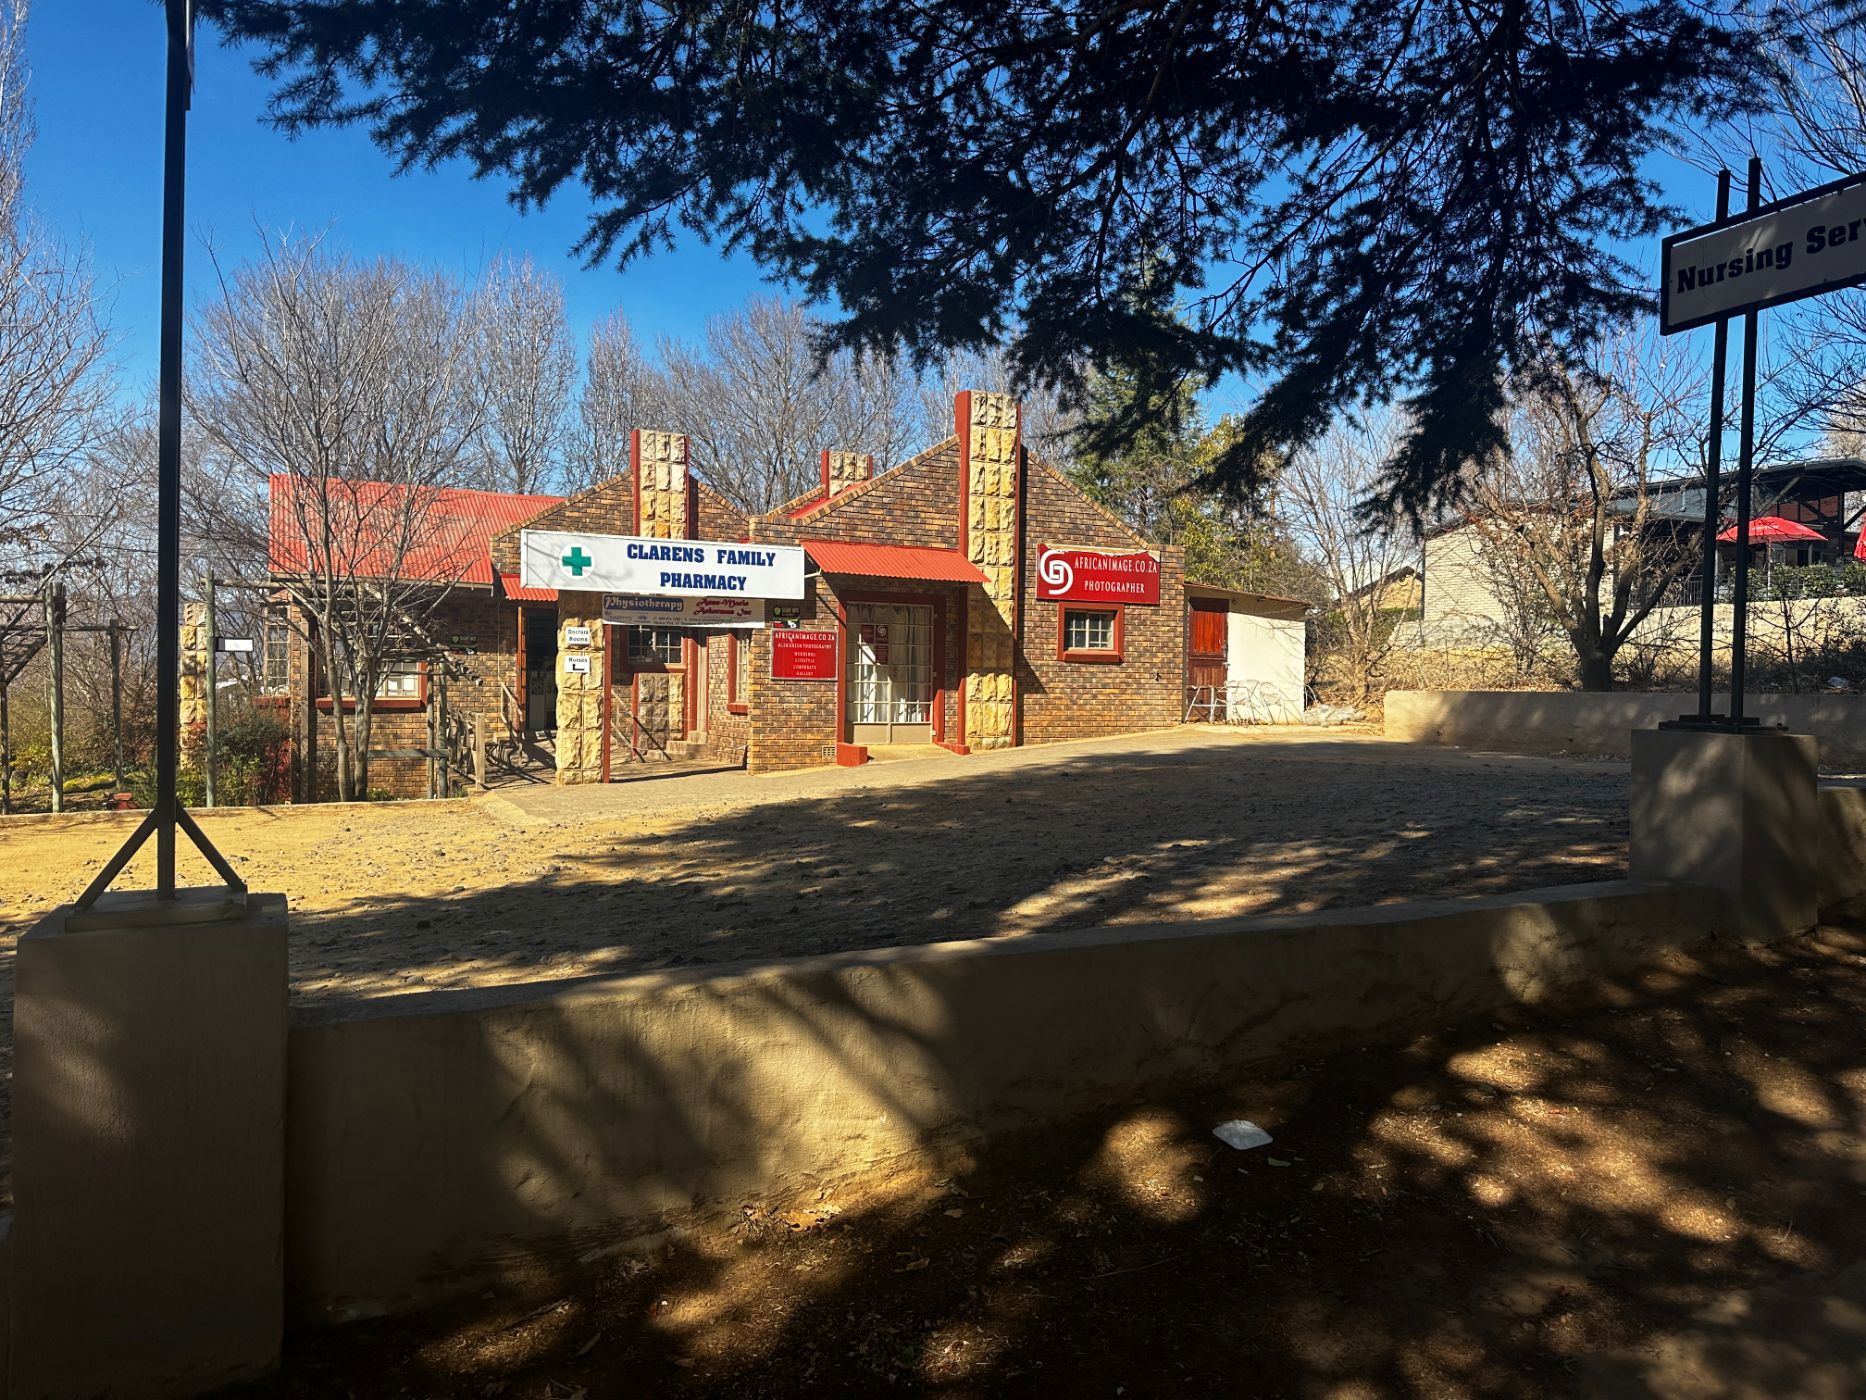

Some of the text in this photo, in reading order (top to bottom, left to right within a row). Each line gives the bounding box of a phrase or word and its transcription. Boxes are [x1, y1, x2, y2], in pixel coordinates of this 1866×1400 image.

[1677, 217, 1866, 294] Nursing Ser
[627, 543, 776, 567] CLARENS FAMILY
[1074, 557, 1157, 573] AFRICANIMAGE.CO.ZA
[660, 571, 747, 591] PHARMACY
[1084, 580, 1145, 594] PHOTOGRAPHER
[604, 596, 683, 611] Physiotherapy
